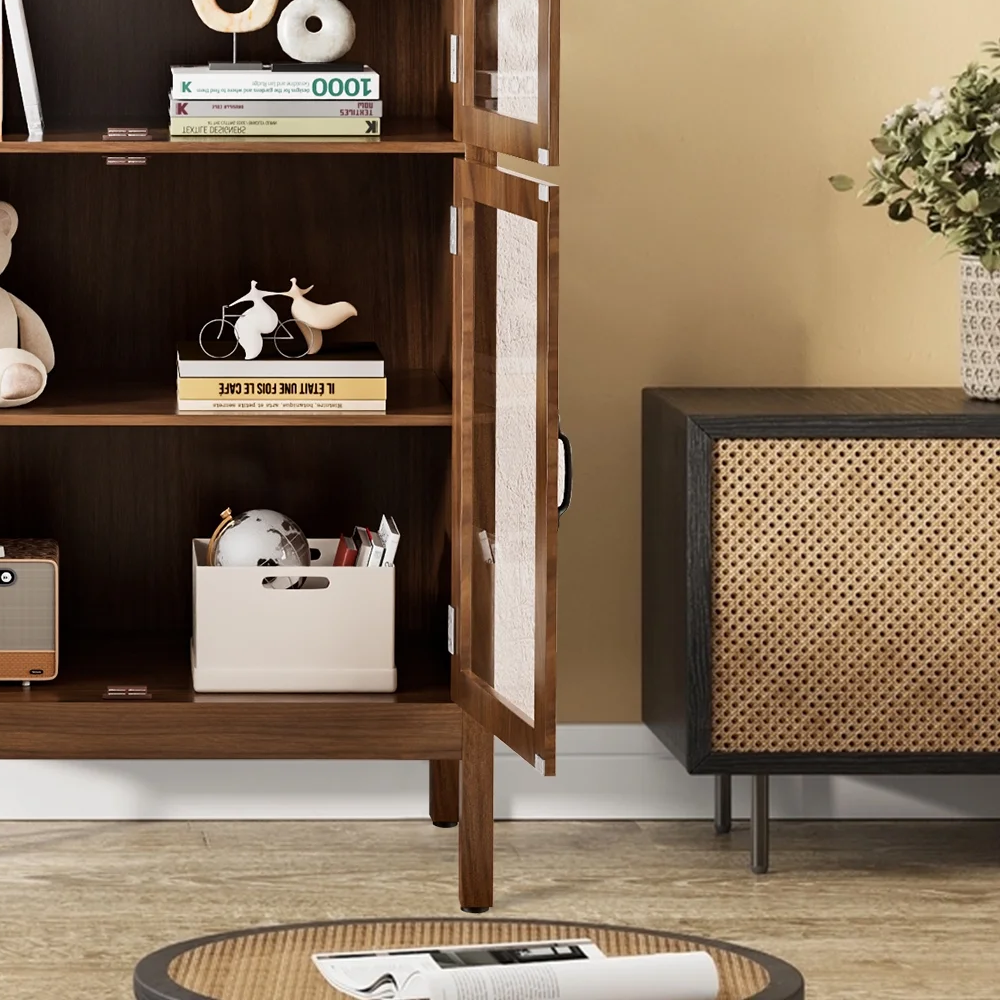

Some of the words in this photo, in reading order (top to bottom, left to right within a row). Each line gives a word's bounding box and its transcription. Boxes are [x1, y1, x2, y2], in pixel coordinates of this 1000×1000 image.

[182, 82, 192, 92] K
[312, 78, 372, 96] 1000
[176, 103, 189, 115] K
[219, 383, 242, 396] CAFÉ
[244, 383, 254, 394] LE
[257, 383, 276, 394] FOIS
[279, 383, 297, 394] UNE
[300, 383, 324, 396] ÉTAIT
[327, 383, 335, 394] IL
